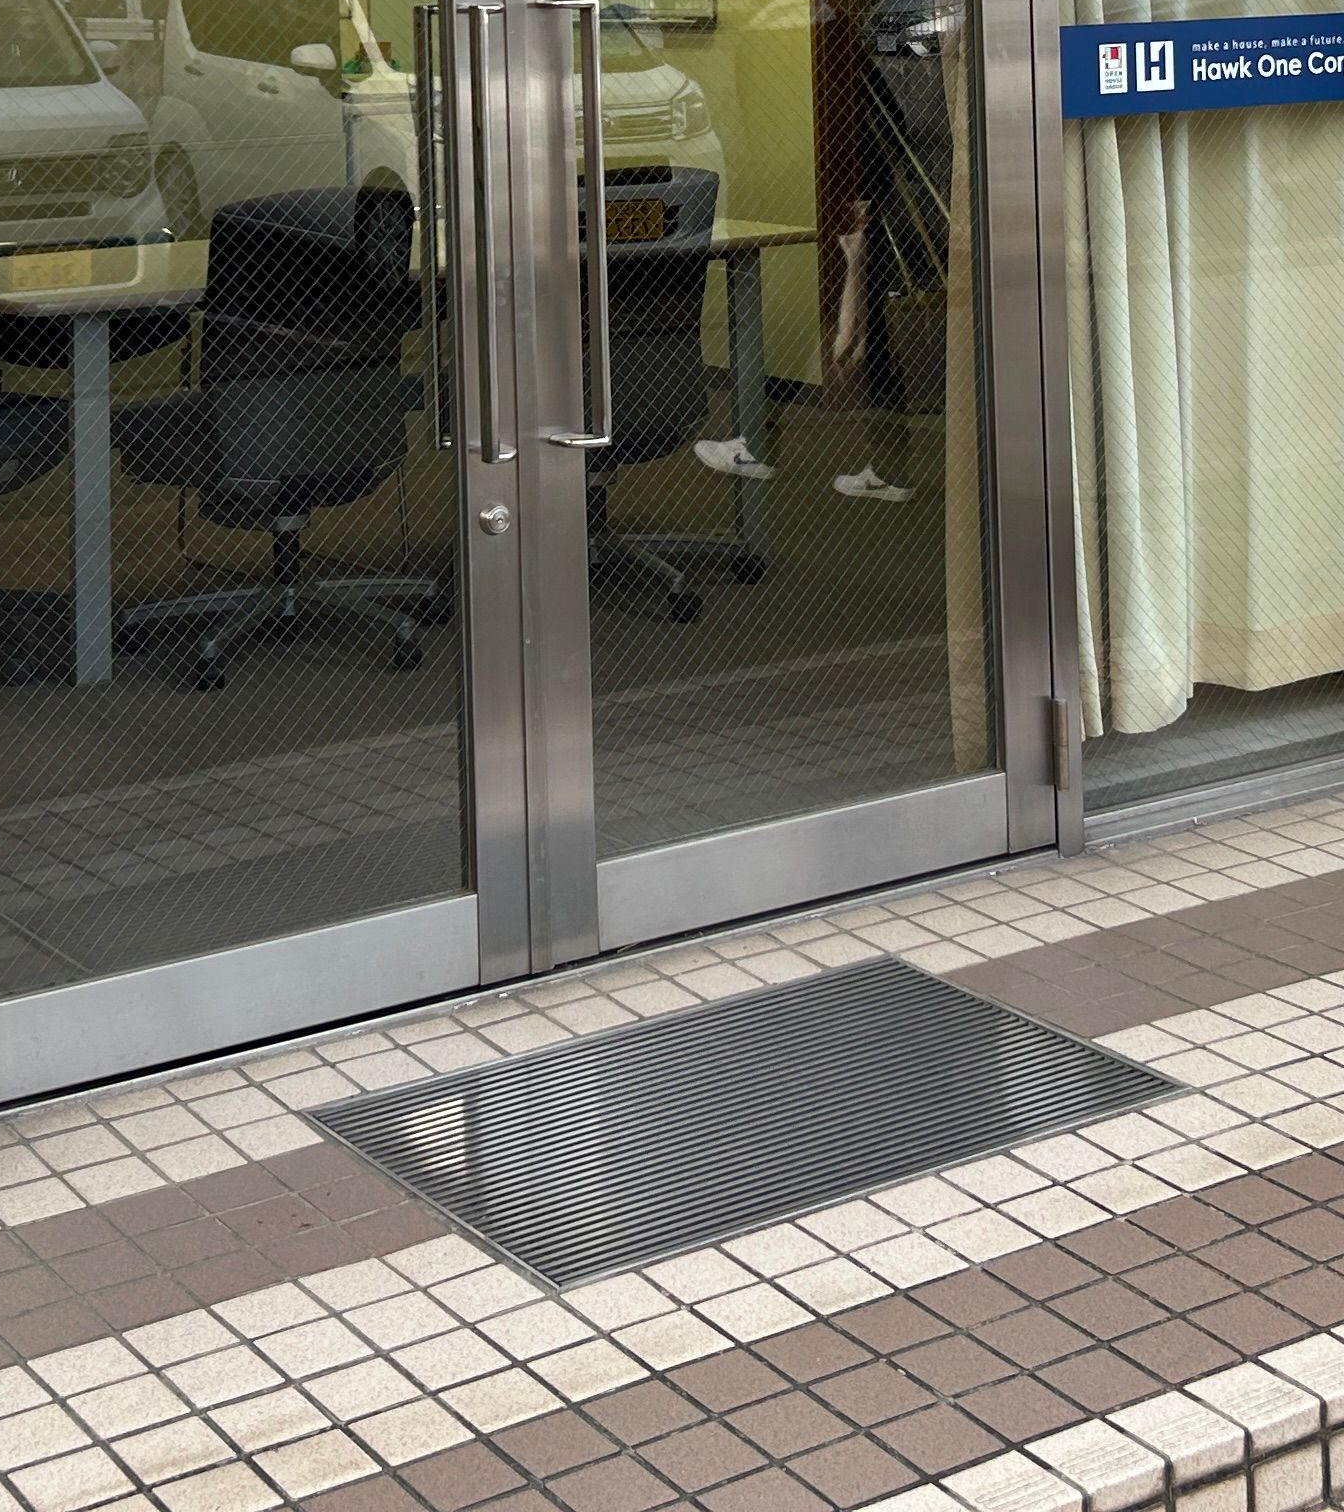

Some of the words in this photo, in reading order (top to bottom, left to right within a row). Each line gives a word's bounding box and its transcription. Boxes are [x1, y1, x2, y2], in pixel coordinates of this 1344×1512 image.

[1192, 40, 1220, 52] make
[1223, 41, 1229, 50] a
[1271, 36, 1298, 48] make
[1301, 38, 1307, 46] a
[1192, 55, 1253, 82] Hawk
[1257, 53, 1303, 78] One
